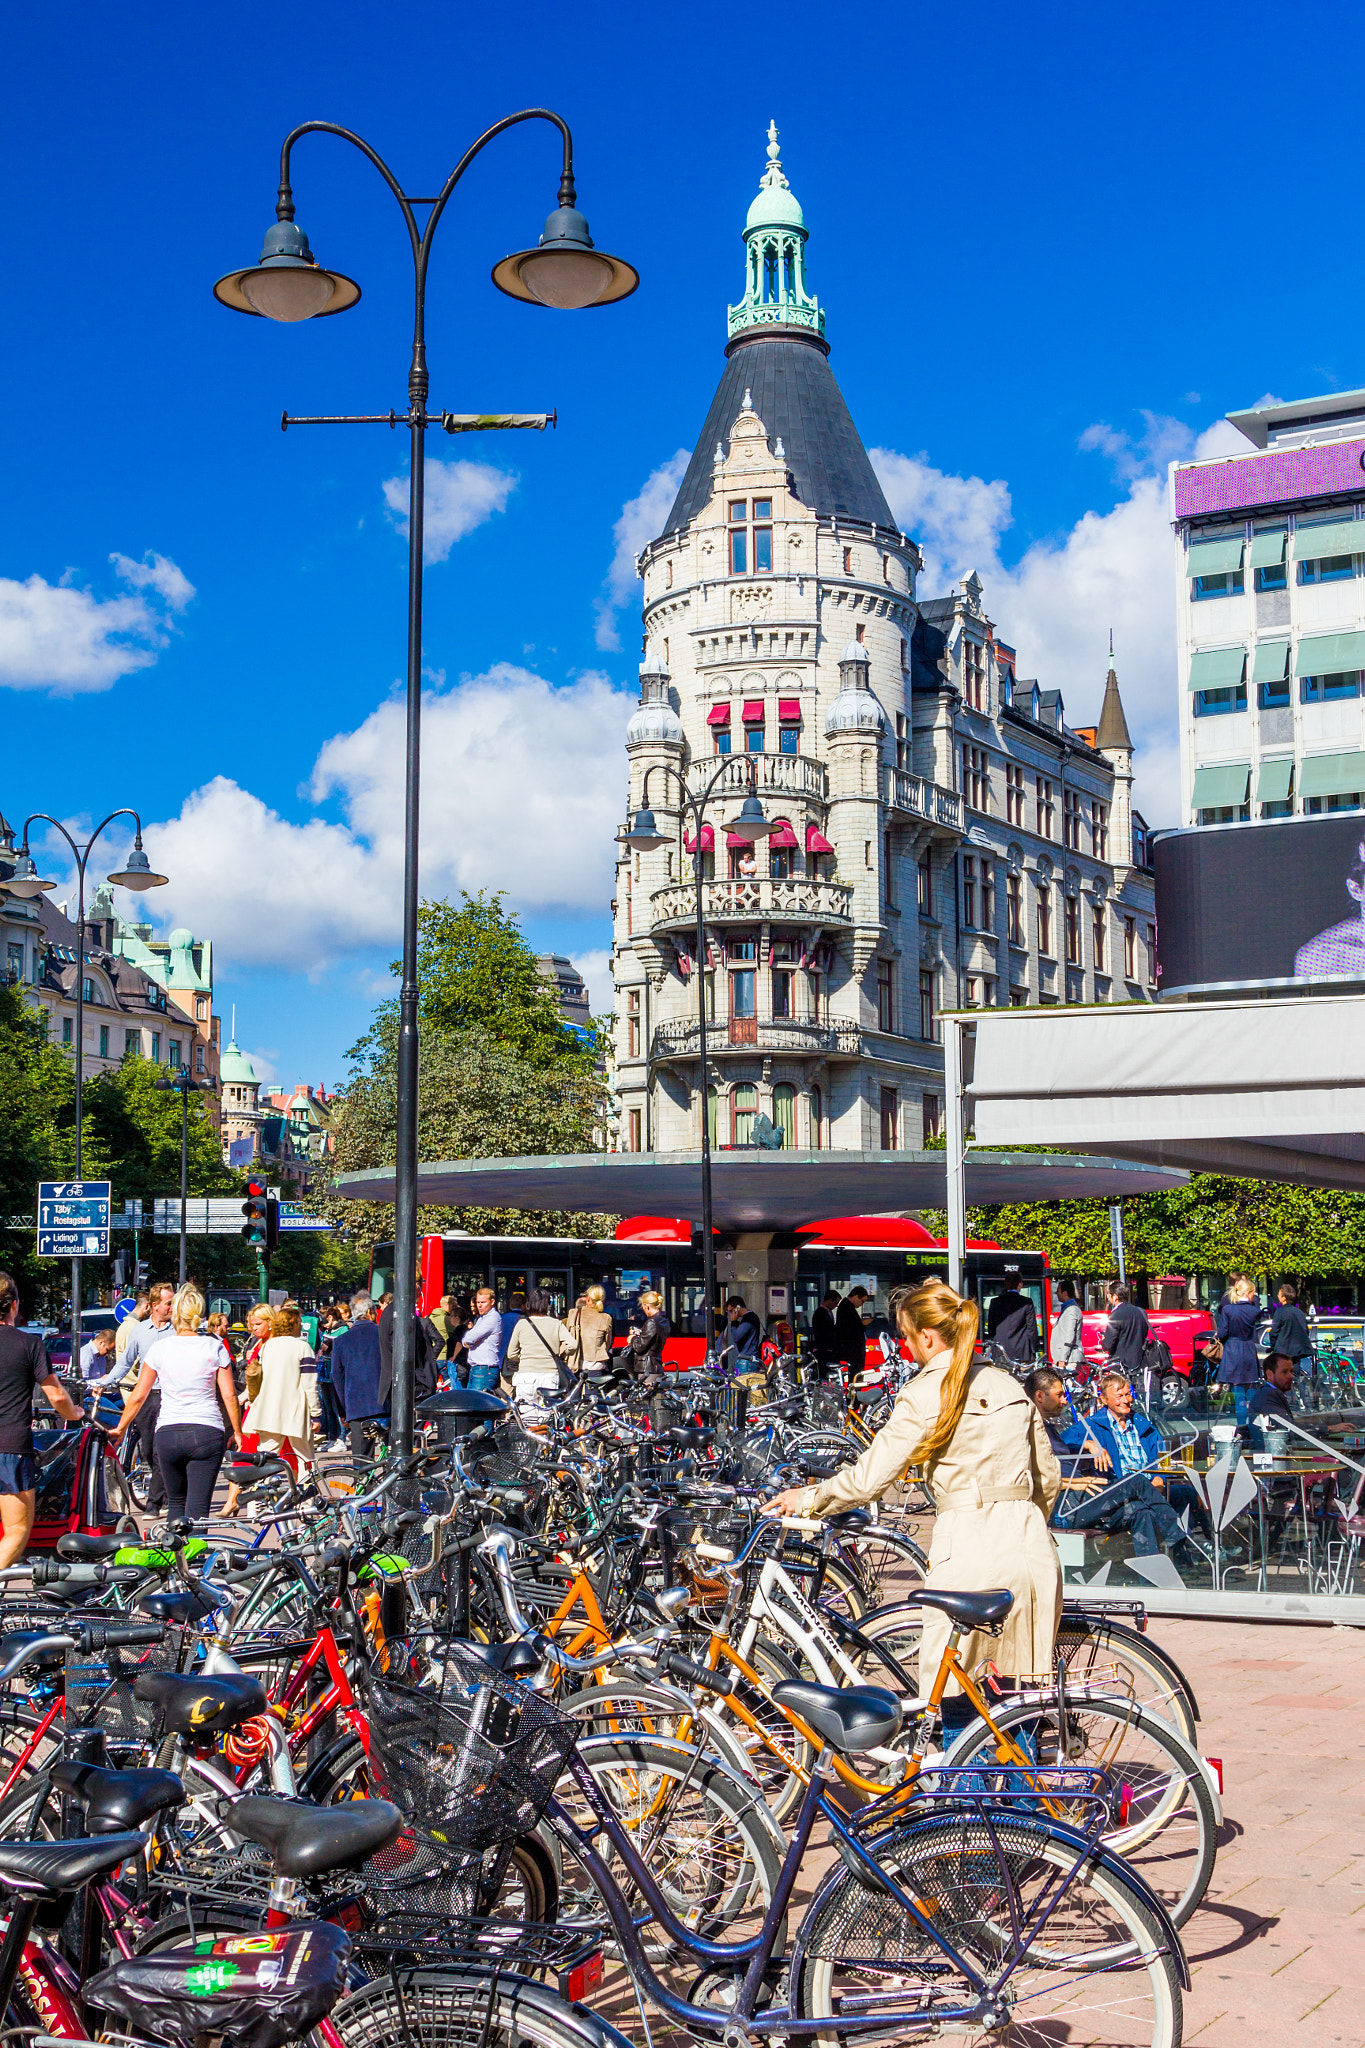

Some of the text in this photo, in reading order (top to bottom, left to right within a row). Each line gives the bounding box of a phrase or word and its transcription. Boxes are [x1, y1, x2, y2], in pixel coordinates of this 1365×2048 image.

[54, 1204, 71, 1215] Täby
[98, 1204, 107, 1213] 13
[53, 1216, 91, 1226] Roslagstull
[101, 1215, 106, 1224] 2
[53, 1233, 78, 1243] Lidingö
[100, 1232, 106, 1240] 5
[53, 1244, 84, 1254] Karlaplan
[100, 1244, 106, 1252] 3
[906, 1254, 917, 1266] 55
[792, 1590, 842, 1656] MONARK
[768, 1737, 802, 1771] PUCH
[573, 1765, 606, 1814] Shopping
